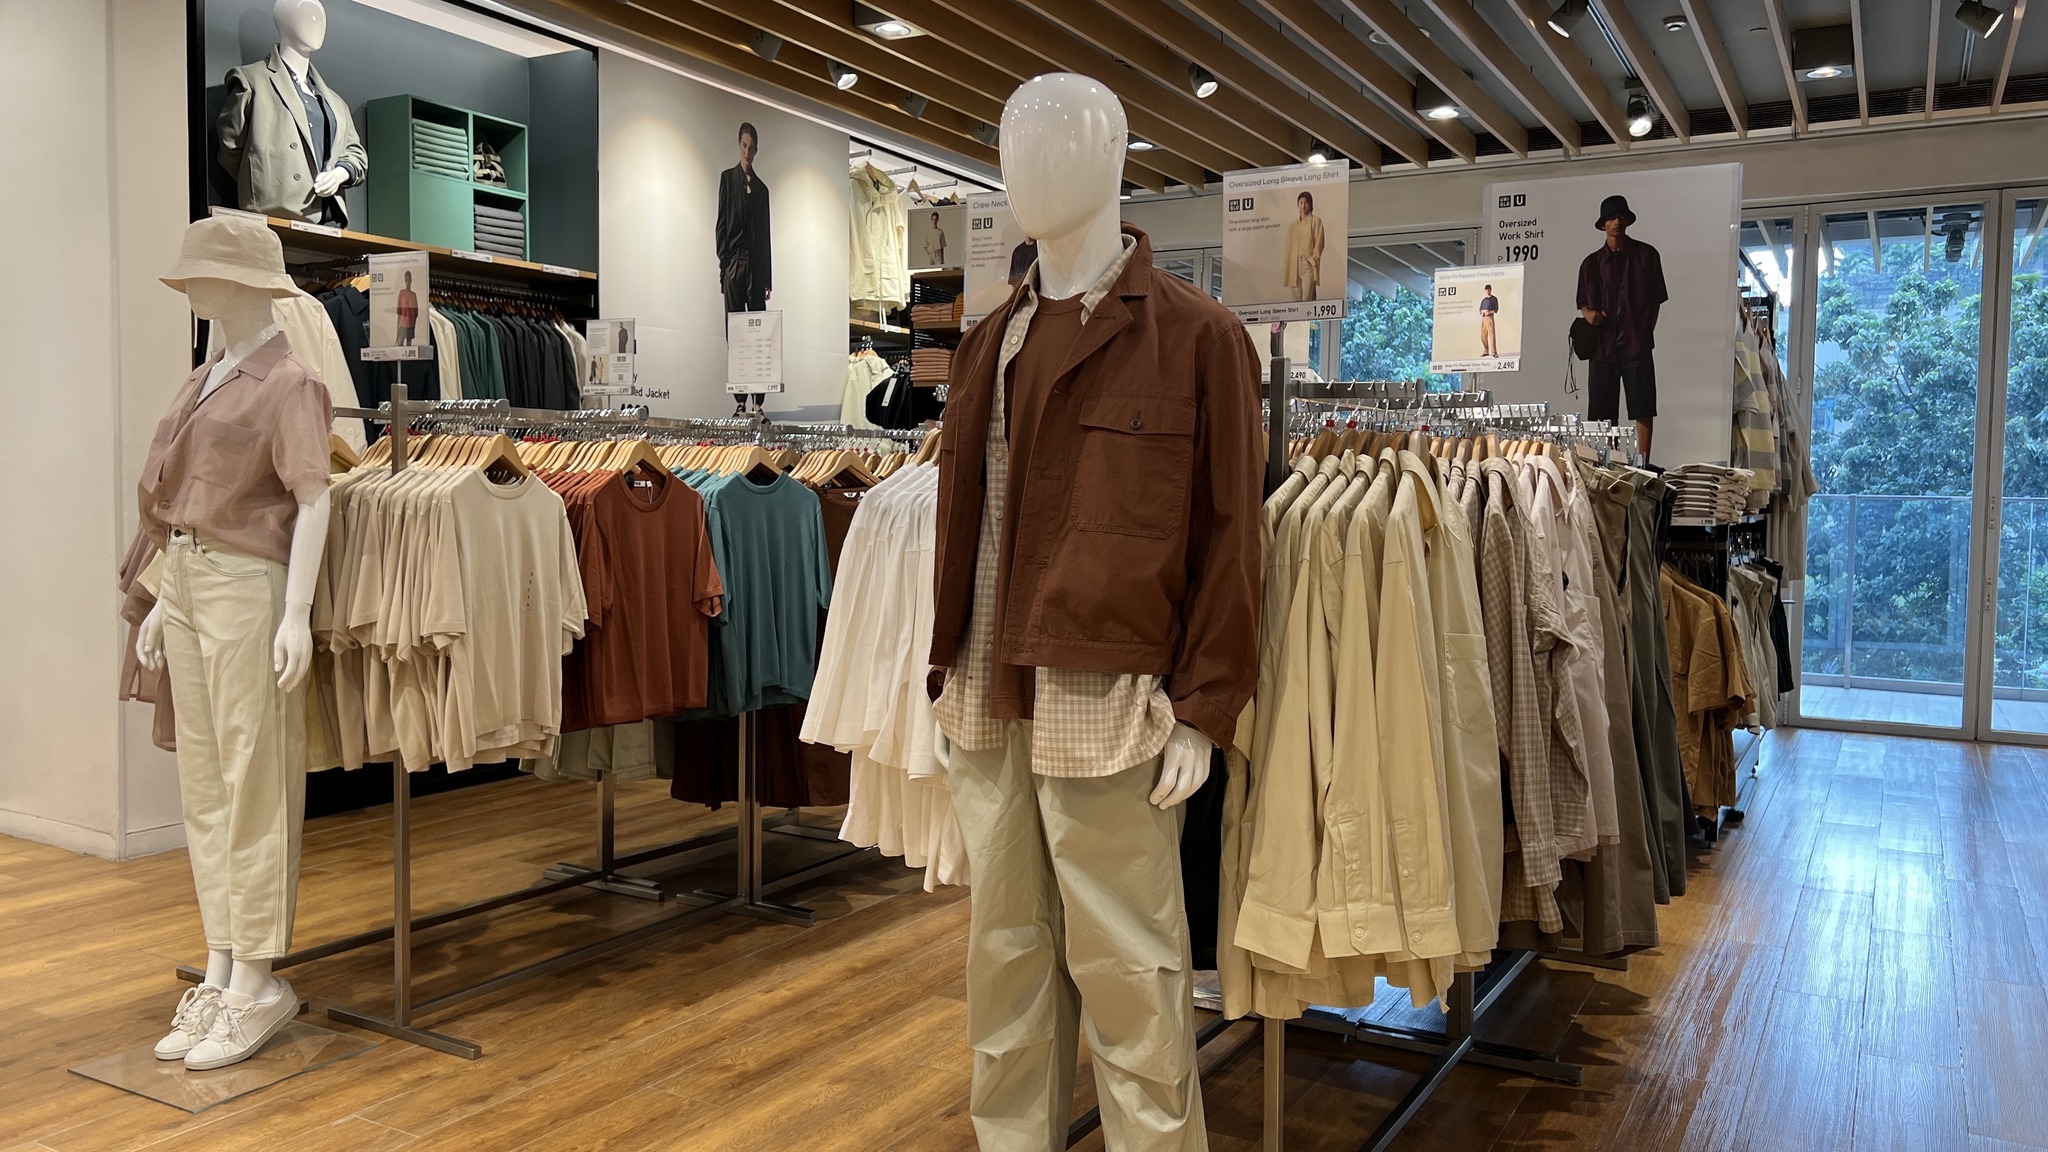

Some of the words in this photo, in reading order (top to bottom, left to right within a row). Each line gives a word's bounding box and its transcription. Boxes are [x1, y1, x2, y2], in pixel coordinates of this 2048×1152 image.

[1229, 179, 1262, 188] Oversized
[1263, 178, 1280, 186] Long
[1304, 173, 1322, 182] Long
[973, 201, 990, 209] Crew
[991, 200, 1008, 208] Neck
[1499, 218, 1537, 228] Oversized
[1499, 232, 1521, 240] Work
[1524, 230, 1544, 239] Shirt
[646, 388, 670, 399] Jacket
